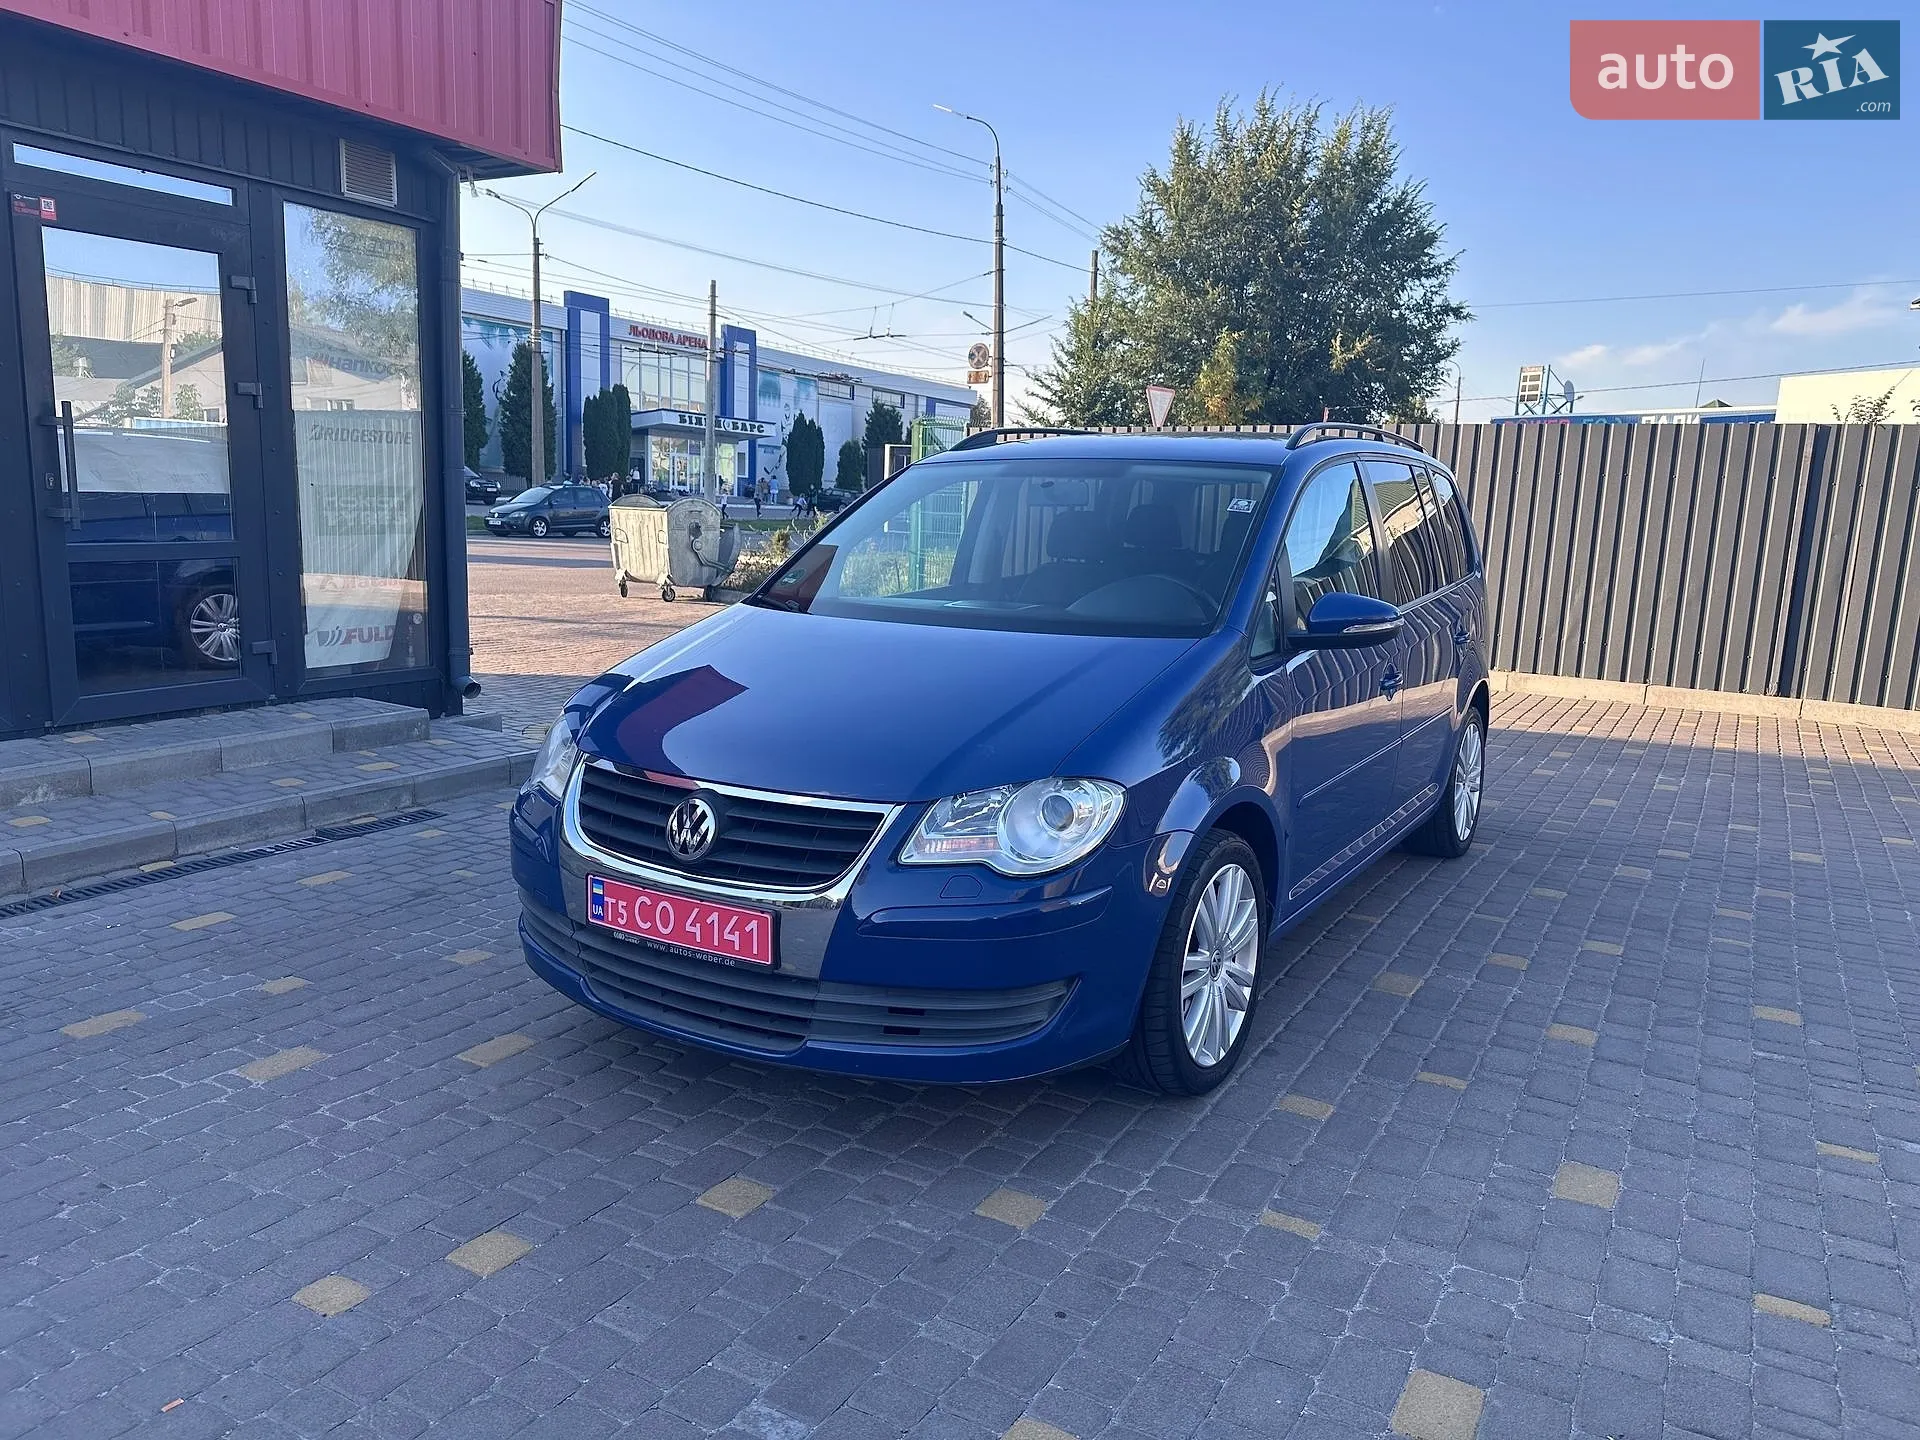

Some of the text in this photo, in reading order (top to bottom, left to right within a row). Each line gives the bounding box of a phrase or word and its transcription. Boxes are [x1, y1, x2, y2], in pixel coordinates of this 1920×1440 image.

[628, 324, 708, 349] ЛЬОДОВА АРЕНА
[678, 413, 765, 434] БІЛЙ БАРС
[309, 424, 414, 445] BRIDGESTONE
[592, 904, 604, 917] UA
[604, 895, 758, 955] T5 CO 4141
